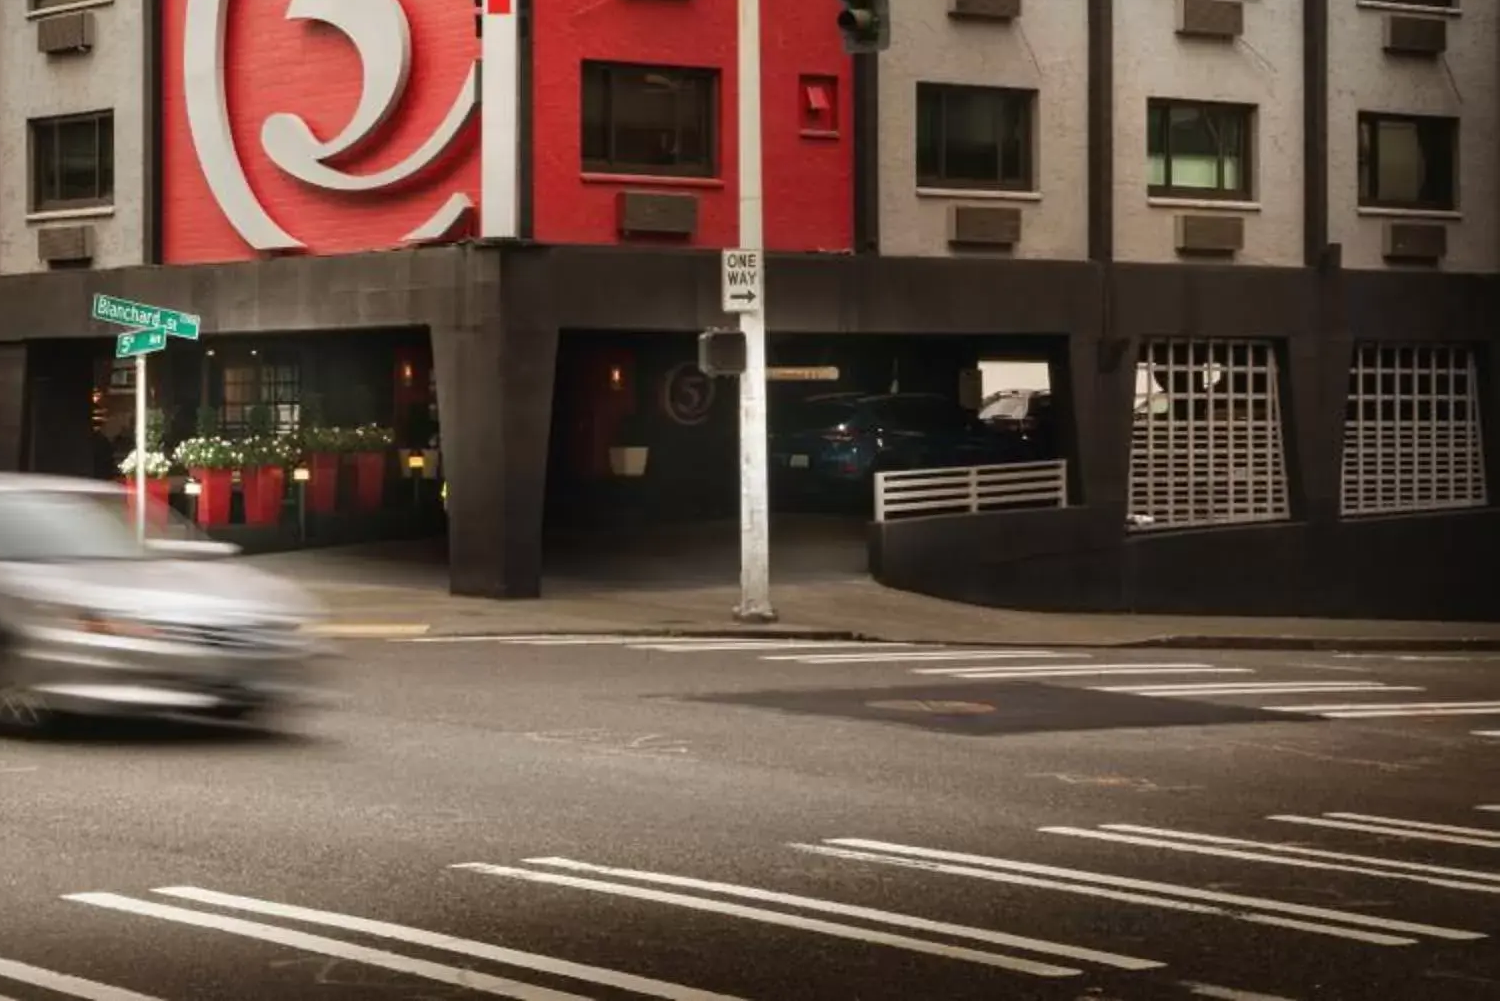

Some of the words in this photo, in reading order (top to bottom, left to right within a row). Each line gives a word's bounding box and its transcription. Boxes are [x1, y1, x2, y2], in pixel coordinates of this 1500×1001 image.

[727, 253, 756, 269] ONE
[727, 270, 756, 287] WAY
[97, 297, 161, 328] Blanchard
